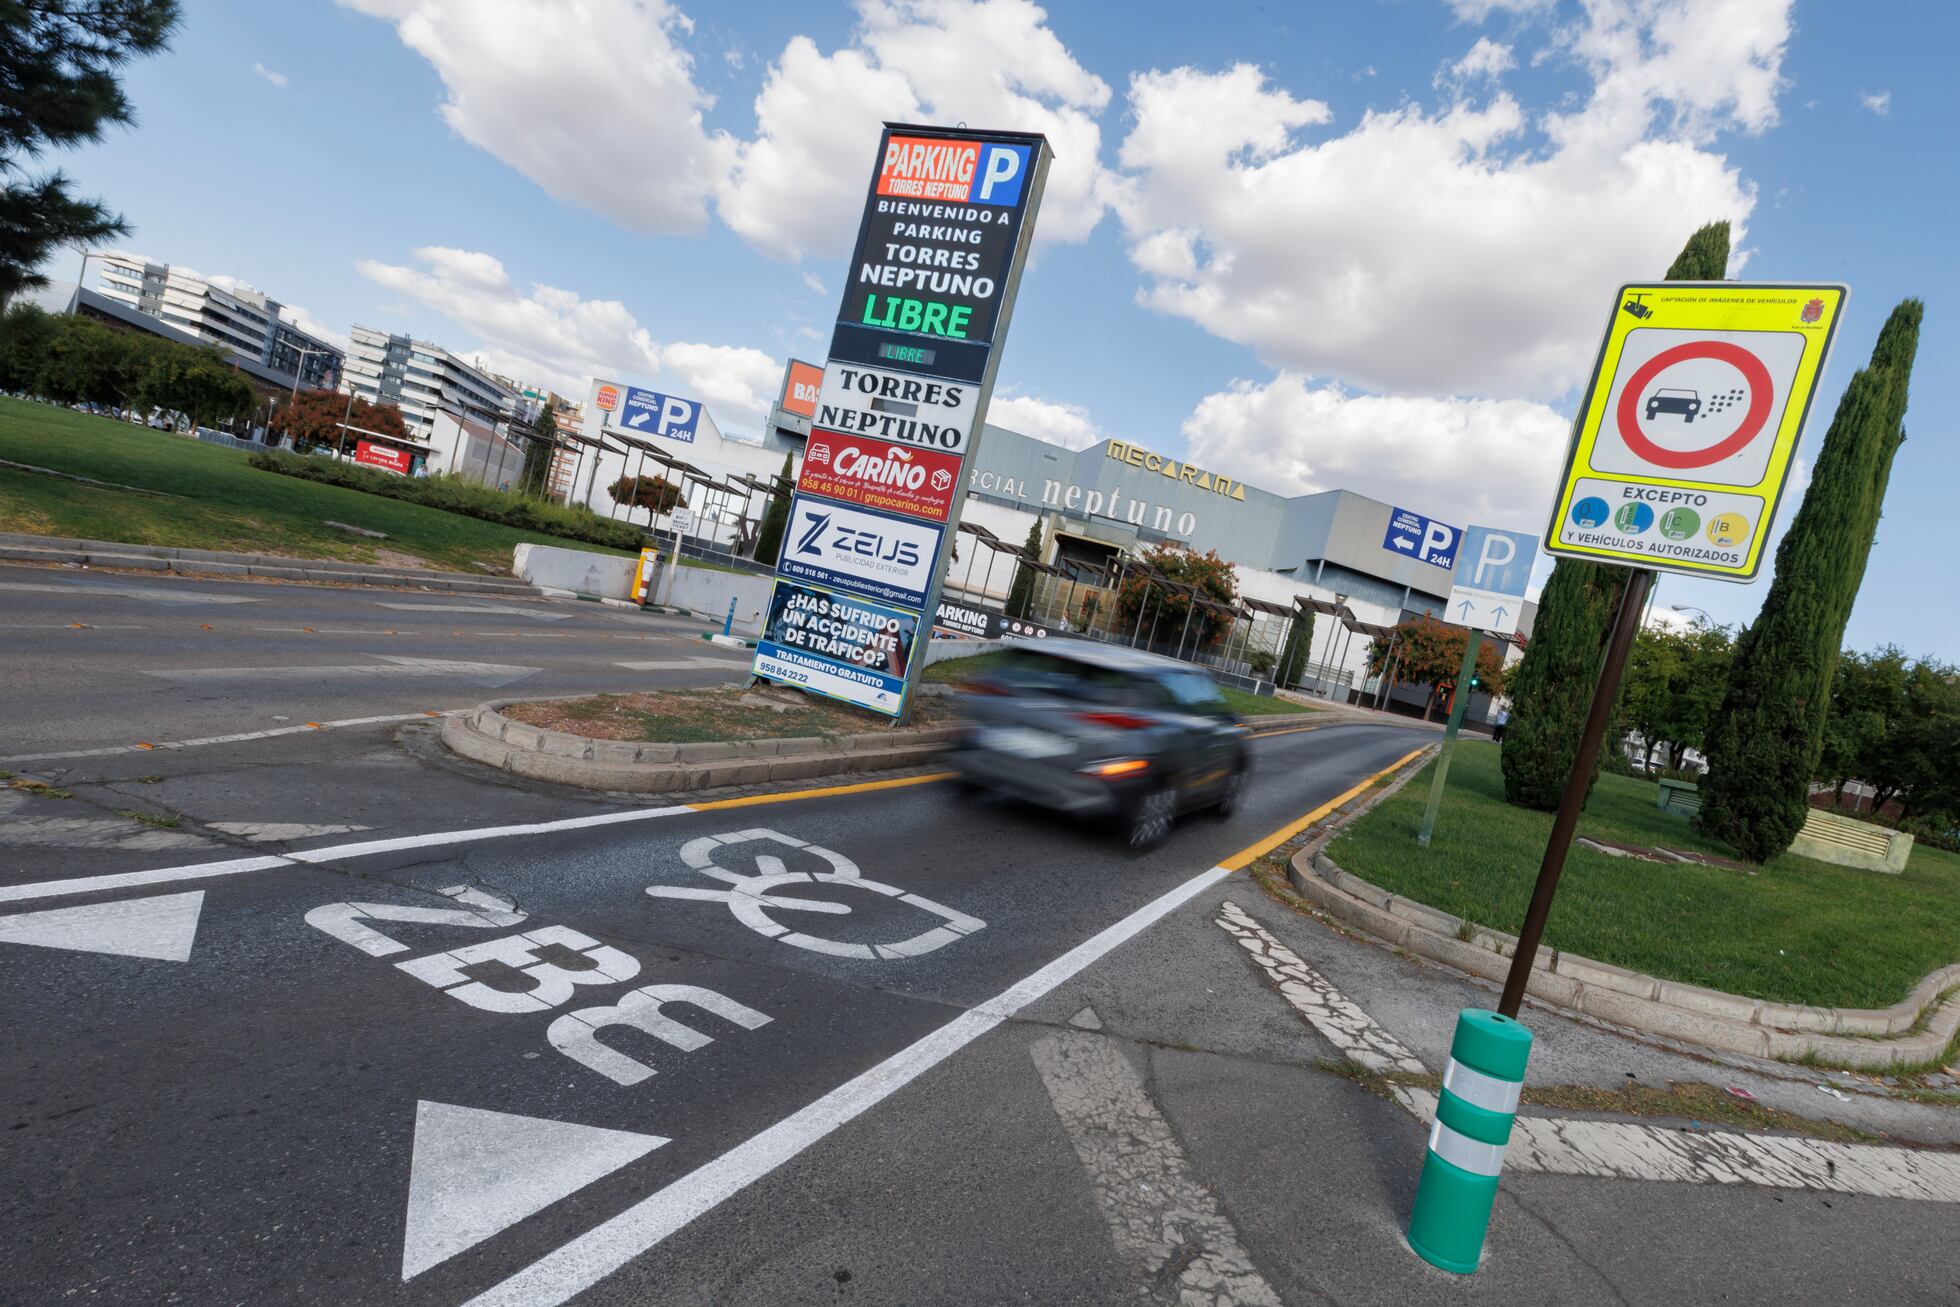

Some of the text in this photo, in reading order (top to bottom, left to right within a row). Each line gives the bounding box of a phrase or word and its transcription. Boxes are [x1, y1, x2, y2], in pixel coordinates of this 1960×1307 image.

[882, 143, 976, 183] PARKING
[980, 148, 1020, 200] P
[888, 178, 969, 200] TORRES NEPTUNO
[878, 200, 1010, 225] BIENVENIDO A
[893, 222, 983, 244] PARKING
[885, 243, 981, 270] TORRES
[859, 263, 994, 298] NEPTUNO
[862, 294, 973, 338] LIBRE
[886, 345, 926, 364] LIBRE
[597, 396, 617, 407] KING
[628, 400, 659, 412] NEPTUNO
[840, 369, 964, 408] TORRES
[657, 397, 692, 435] P
[818, 405, 961, 449] NEPTUNO
[670, 428, 692, 442] 24H.
[970, 468, 1028, 498] RCIAL
[1105, 439, 1245, 501] MEGARAMA
[802, 478, 819, 490] 958
[820, 482, 832, 493] 45
[833, 485, 845, 496] 90
[846, 488, 858, 498] 01
[864, 493, 943, 517] grupocarino.com
[1041, 478, 1196, 537] neptuno
[1622, 487, 1708, 507] EXCEPTO
[1392, 520, 1422, 535] NEPTUNO
[1672, 516, 1682, 526] C
[1719, 522, 1730, 532] B
[832, 526, 919, 567] ZEUS
[1419, 521, 1453, 560] P
[1567, 531, 1739, 563] Y VEHÍCULOS AUTORIZADOS
[835, 552, 909, 577] PUBLICIDAD EXTERIOR
[1474, 533, 1516, 584] P
[792, 565, 804, 574] 609
[804, 568, 816, 577] 518
[817, 571, 829, 580] 561
[832, 576, 922, 604] zeuspubliexterior@gmail.com
[783, 608, 898, 652] UN ACCIDENTE
[786, 593, 900, 634] ¿HAS SUFRIDO
[936, 604, 988, 628] ARKING
[942, 619, 985, 636] TORRES NEPTUNO
[785, 627, 886, 667] DE TRÁFICO?
[760, 662, 809, 683] 958 84 22 22
[776, 649, 884, 688] TRATAMIENTO GRATUITO
[304, 885, 775, 1087] ZBE
